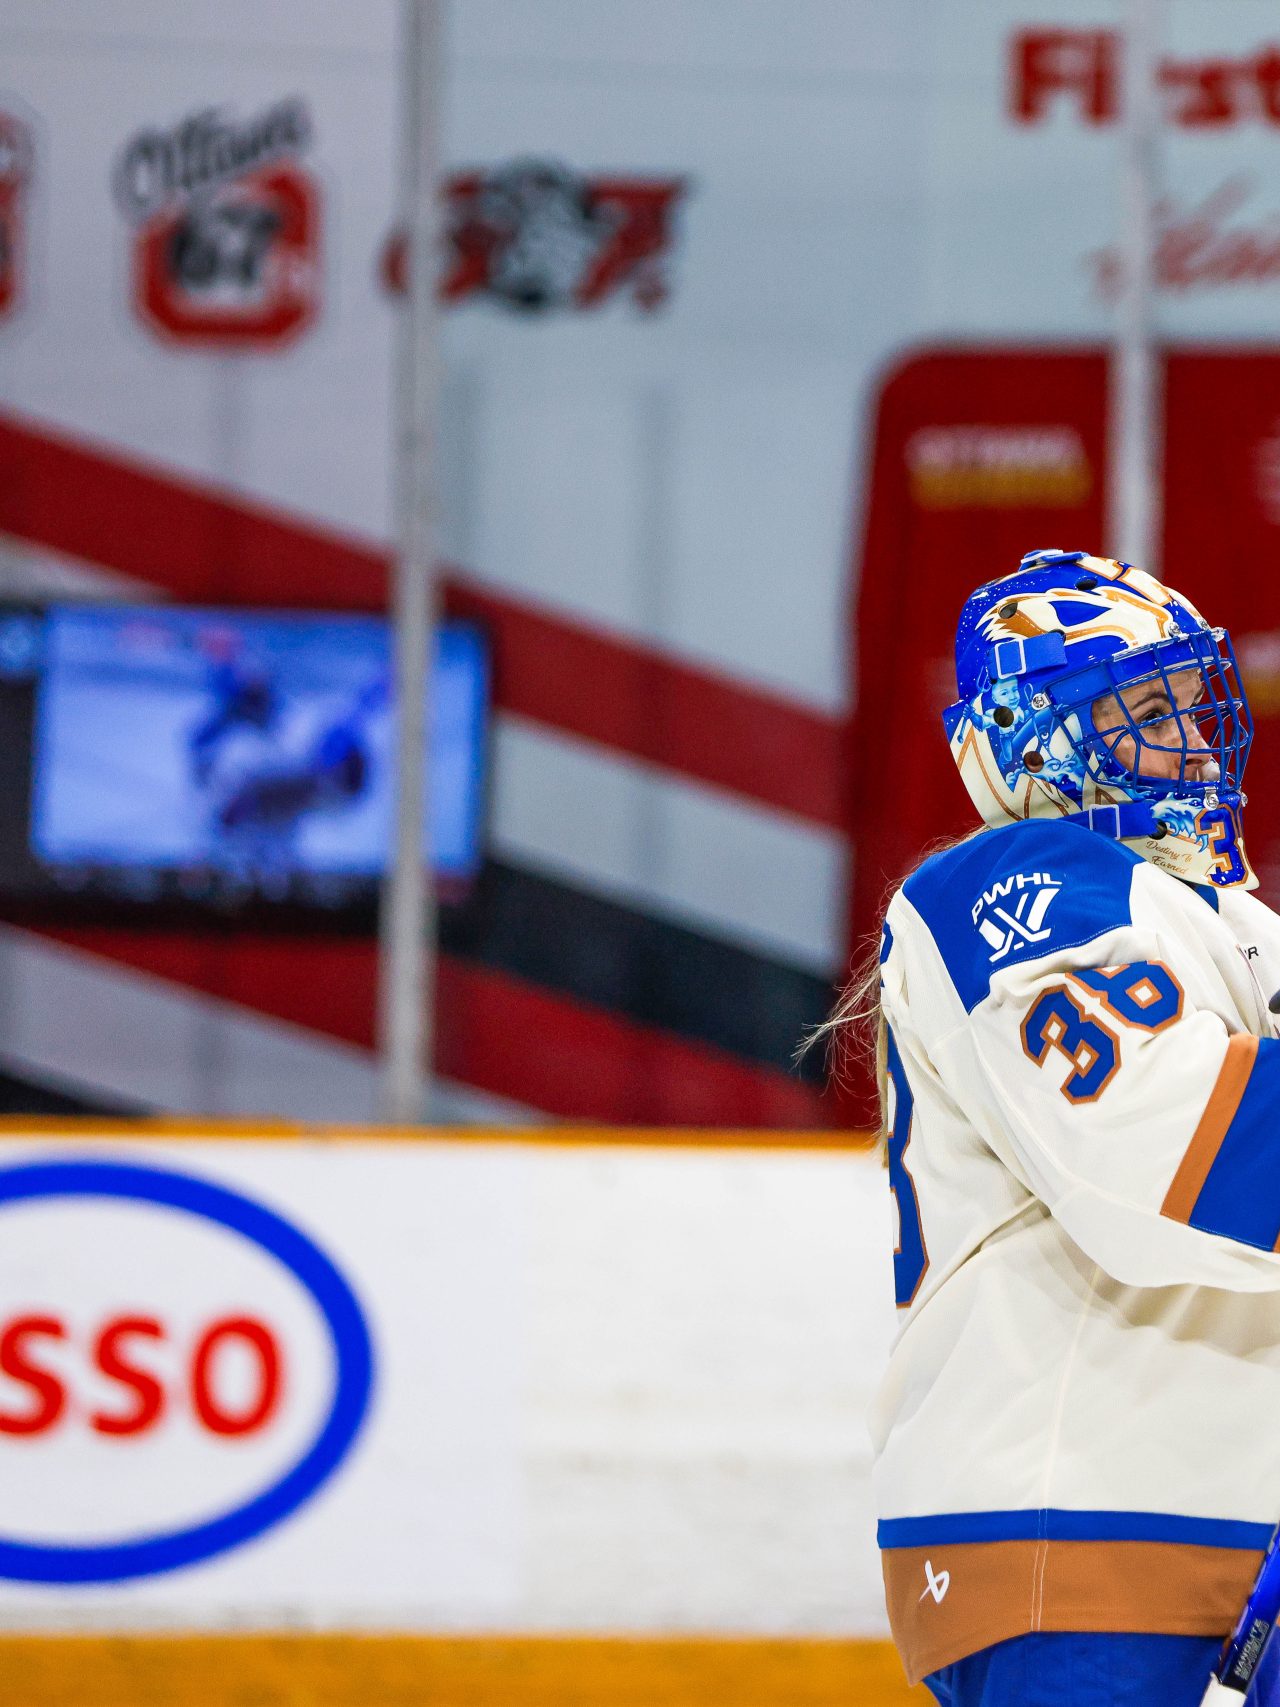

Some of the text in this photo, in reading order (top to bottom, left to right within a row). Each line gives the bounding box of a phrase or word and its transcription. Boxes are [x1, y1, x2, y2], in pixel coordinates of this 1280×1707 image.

[1146, 840, 1181, 860] Destiny
[1152, 855, 1189, 875] Earned
[971, 872, 1063, 926] PWHL
[1019, 959, 1186, 1106] 38
